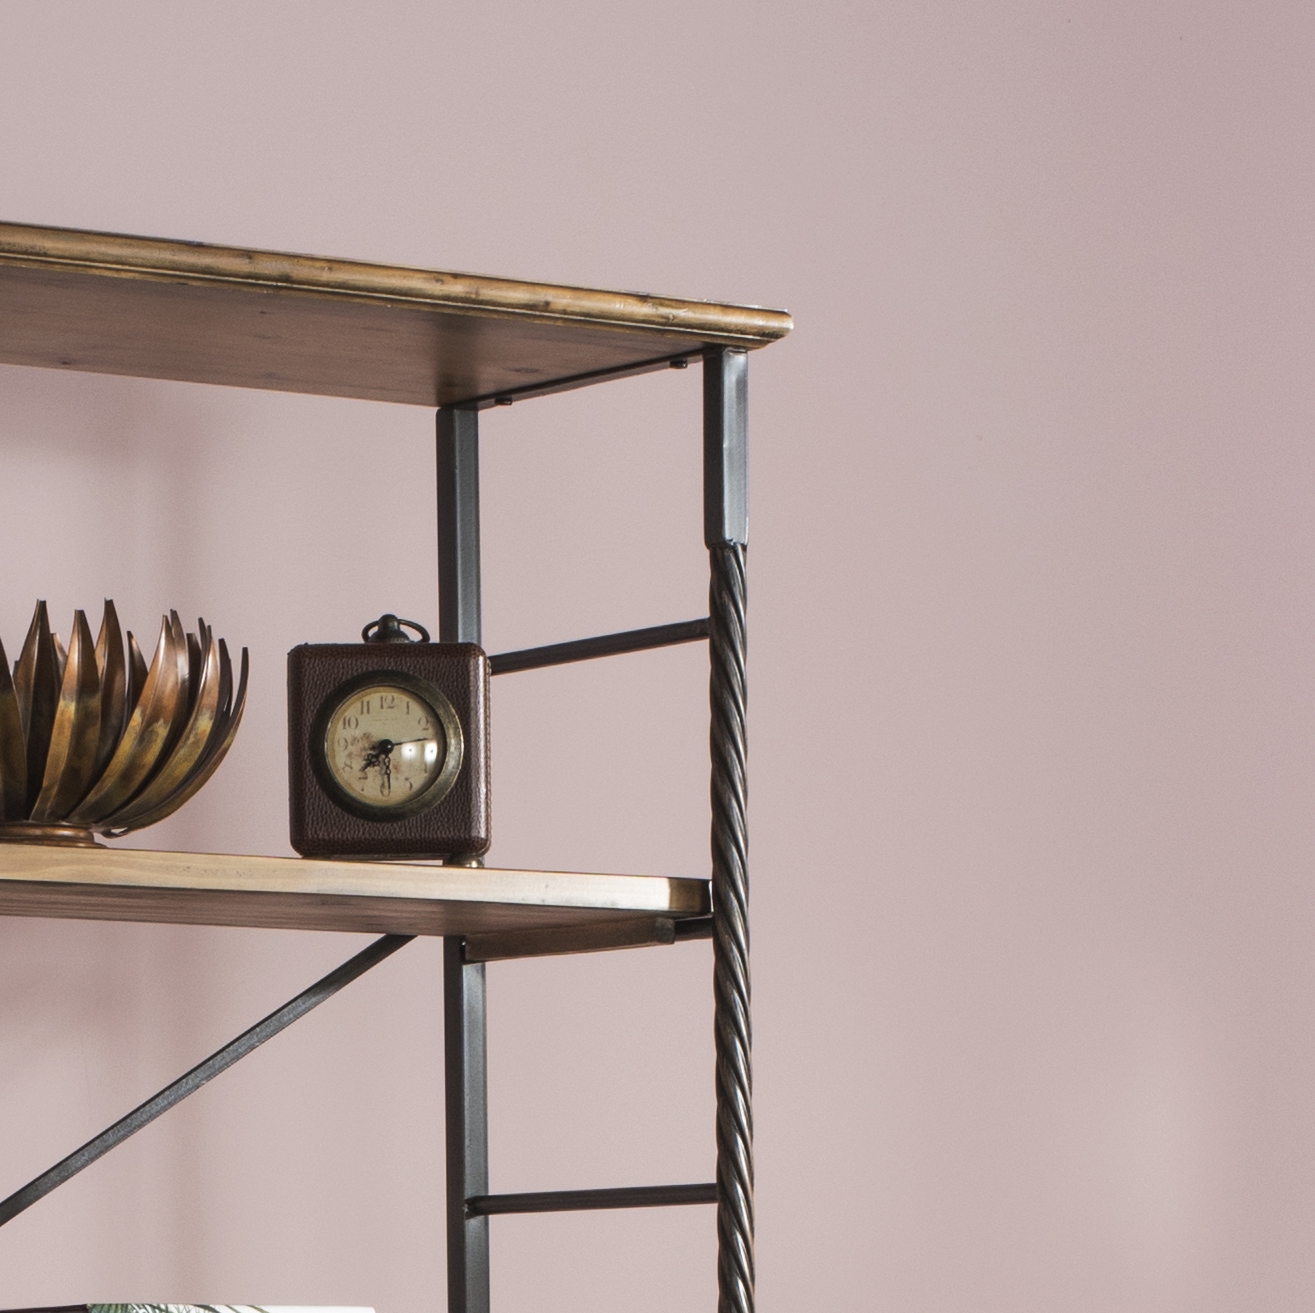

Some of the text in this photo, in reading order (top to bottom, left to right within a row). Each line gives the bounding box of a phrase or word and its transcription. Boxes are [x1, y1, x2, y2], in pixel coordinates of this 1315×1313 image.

[360, 700, 371, 715] 11
[380, 694, 395, 710] 12
[405, 700, 410, 715] 1
[342, 715, 359, 730] 10
[417, 716, 430, 731] 2
